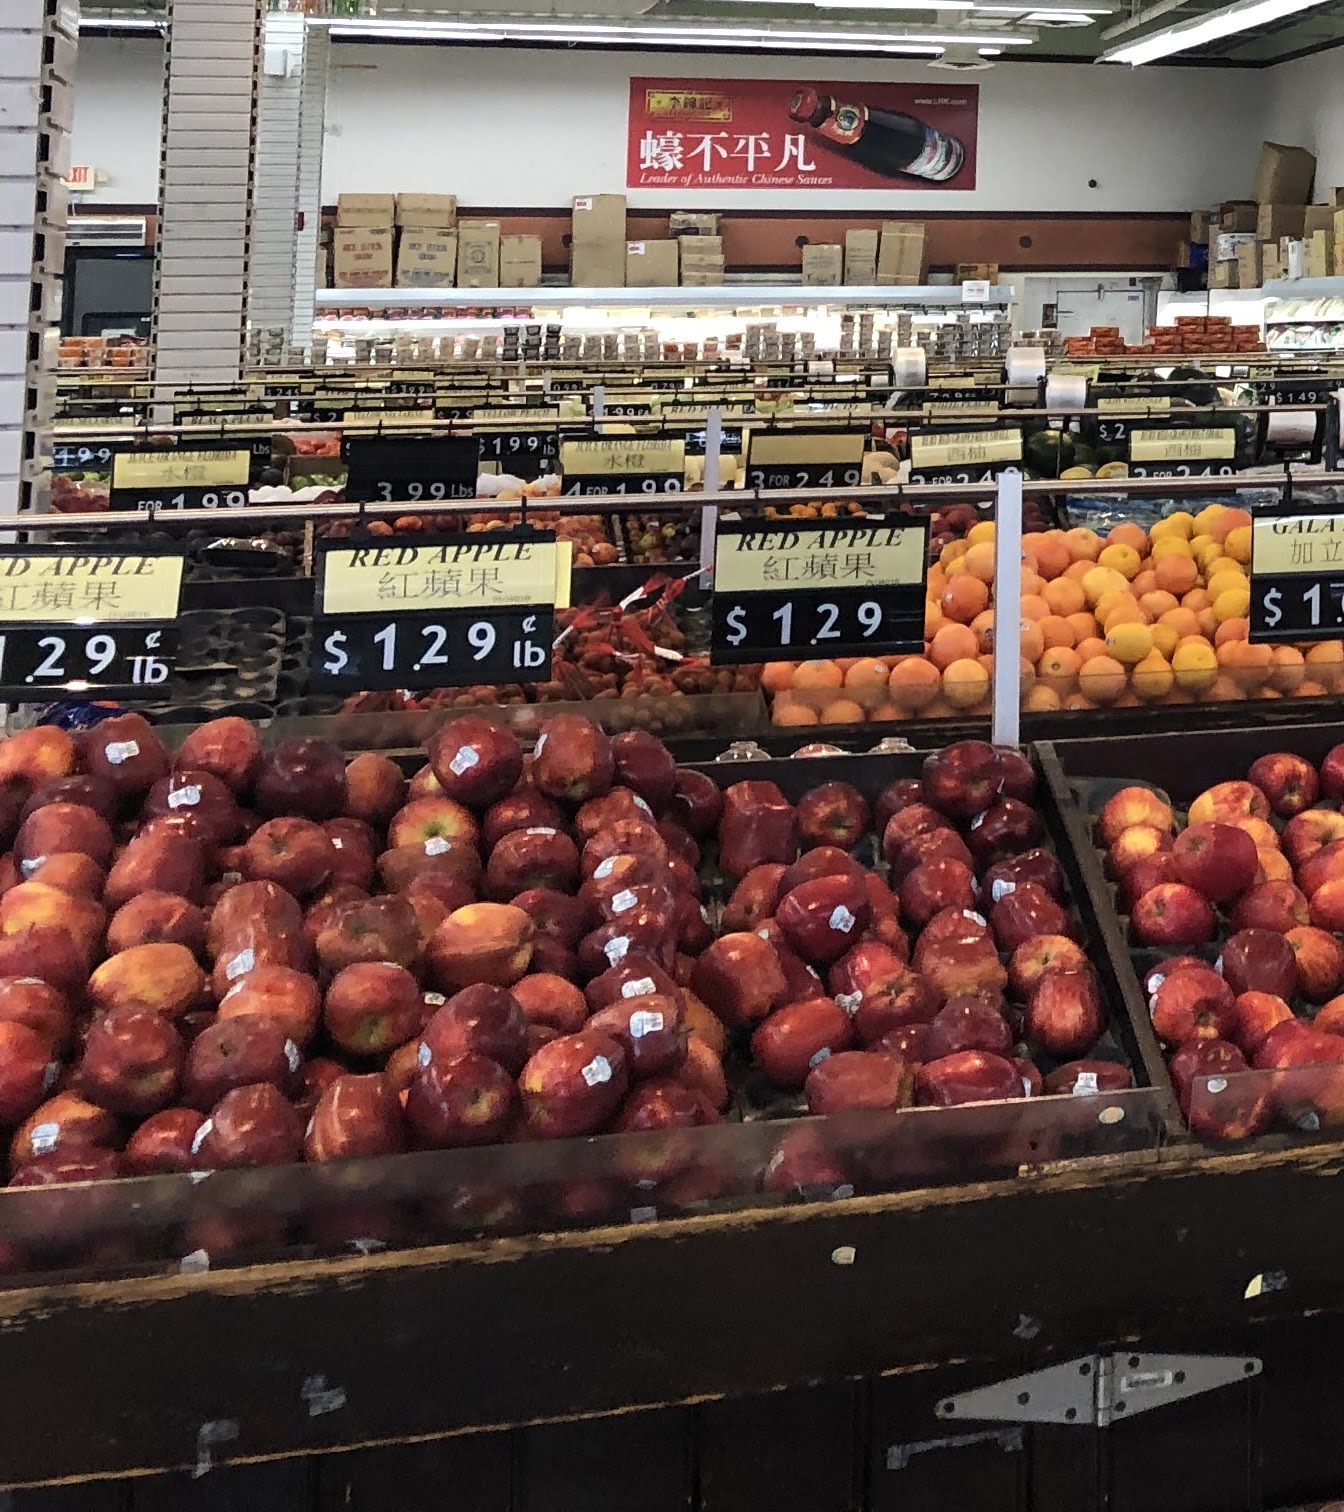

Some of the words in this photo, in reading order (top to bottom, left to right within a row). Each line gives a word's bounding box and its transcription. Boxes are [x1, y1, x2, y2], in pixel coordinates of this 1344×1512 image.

[639, 130, 816, 172] 蠔不平凡
[640, 173, 677, 183] Leader
[681, 173, 692, 186] of
[695, 173, 748, 183] Authentic
[752, 173, 794, 184] Chinese
[797, 174, 832, 185] Sauces
[451, 484, 474, 498] Lbs
[769, 474, 790, 486] FOR
[1272, 517, 1335, 535] GALA
[736, 532, 800, 551] RED
[807, 527, 905, 550] APPLE
[39, 557, 156, 576] APPLE
[348, 546, 420, 568] RED
[428, 542, 534, 565] APPLE
[763, 553, 876, 581] 紅蘋果
[377, 567, 504, 599] 紅蘋果
[513, 640, 546, 669] lb
[132, 656, 169, 685] lb
